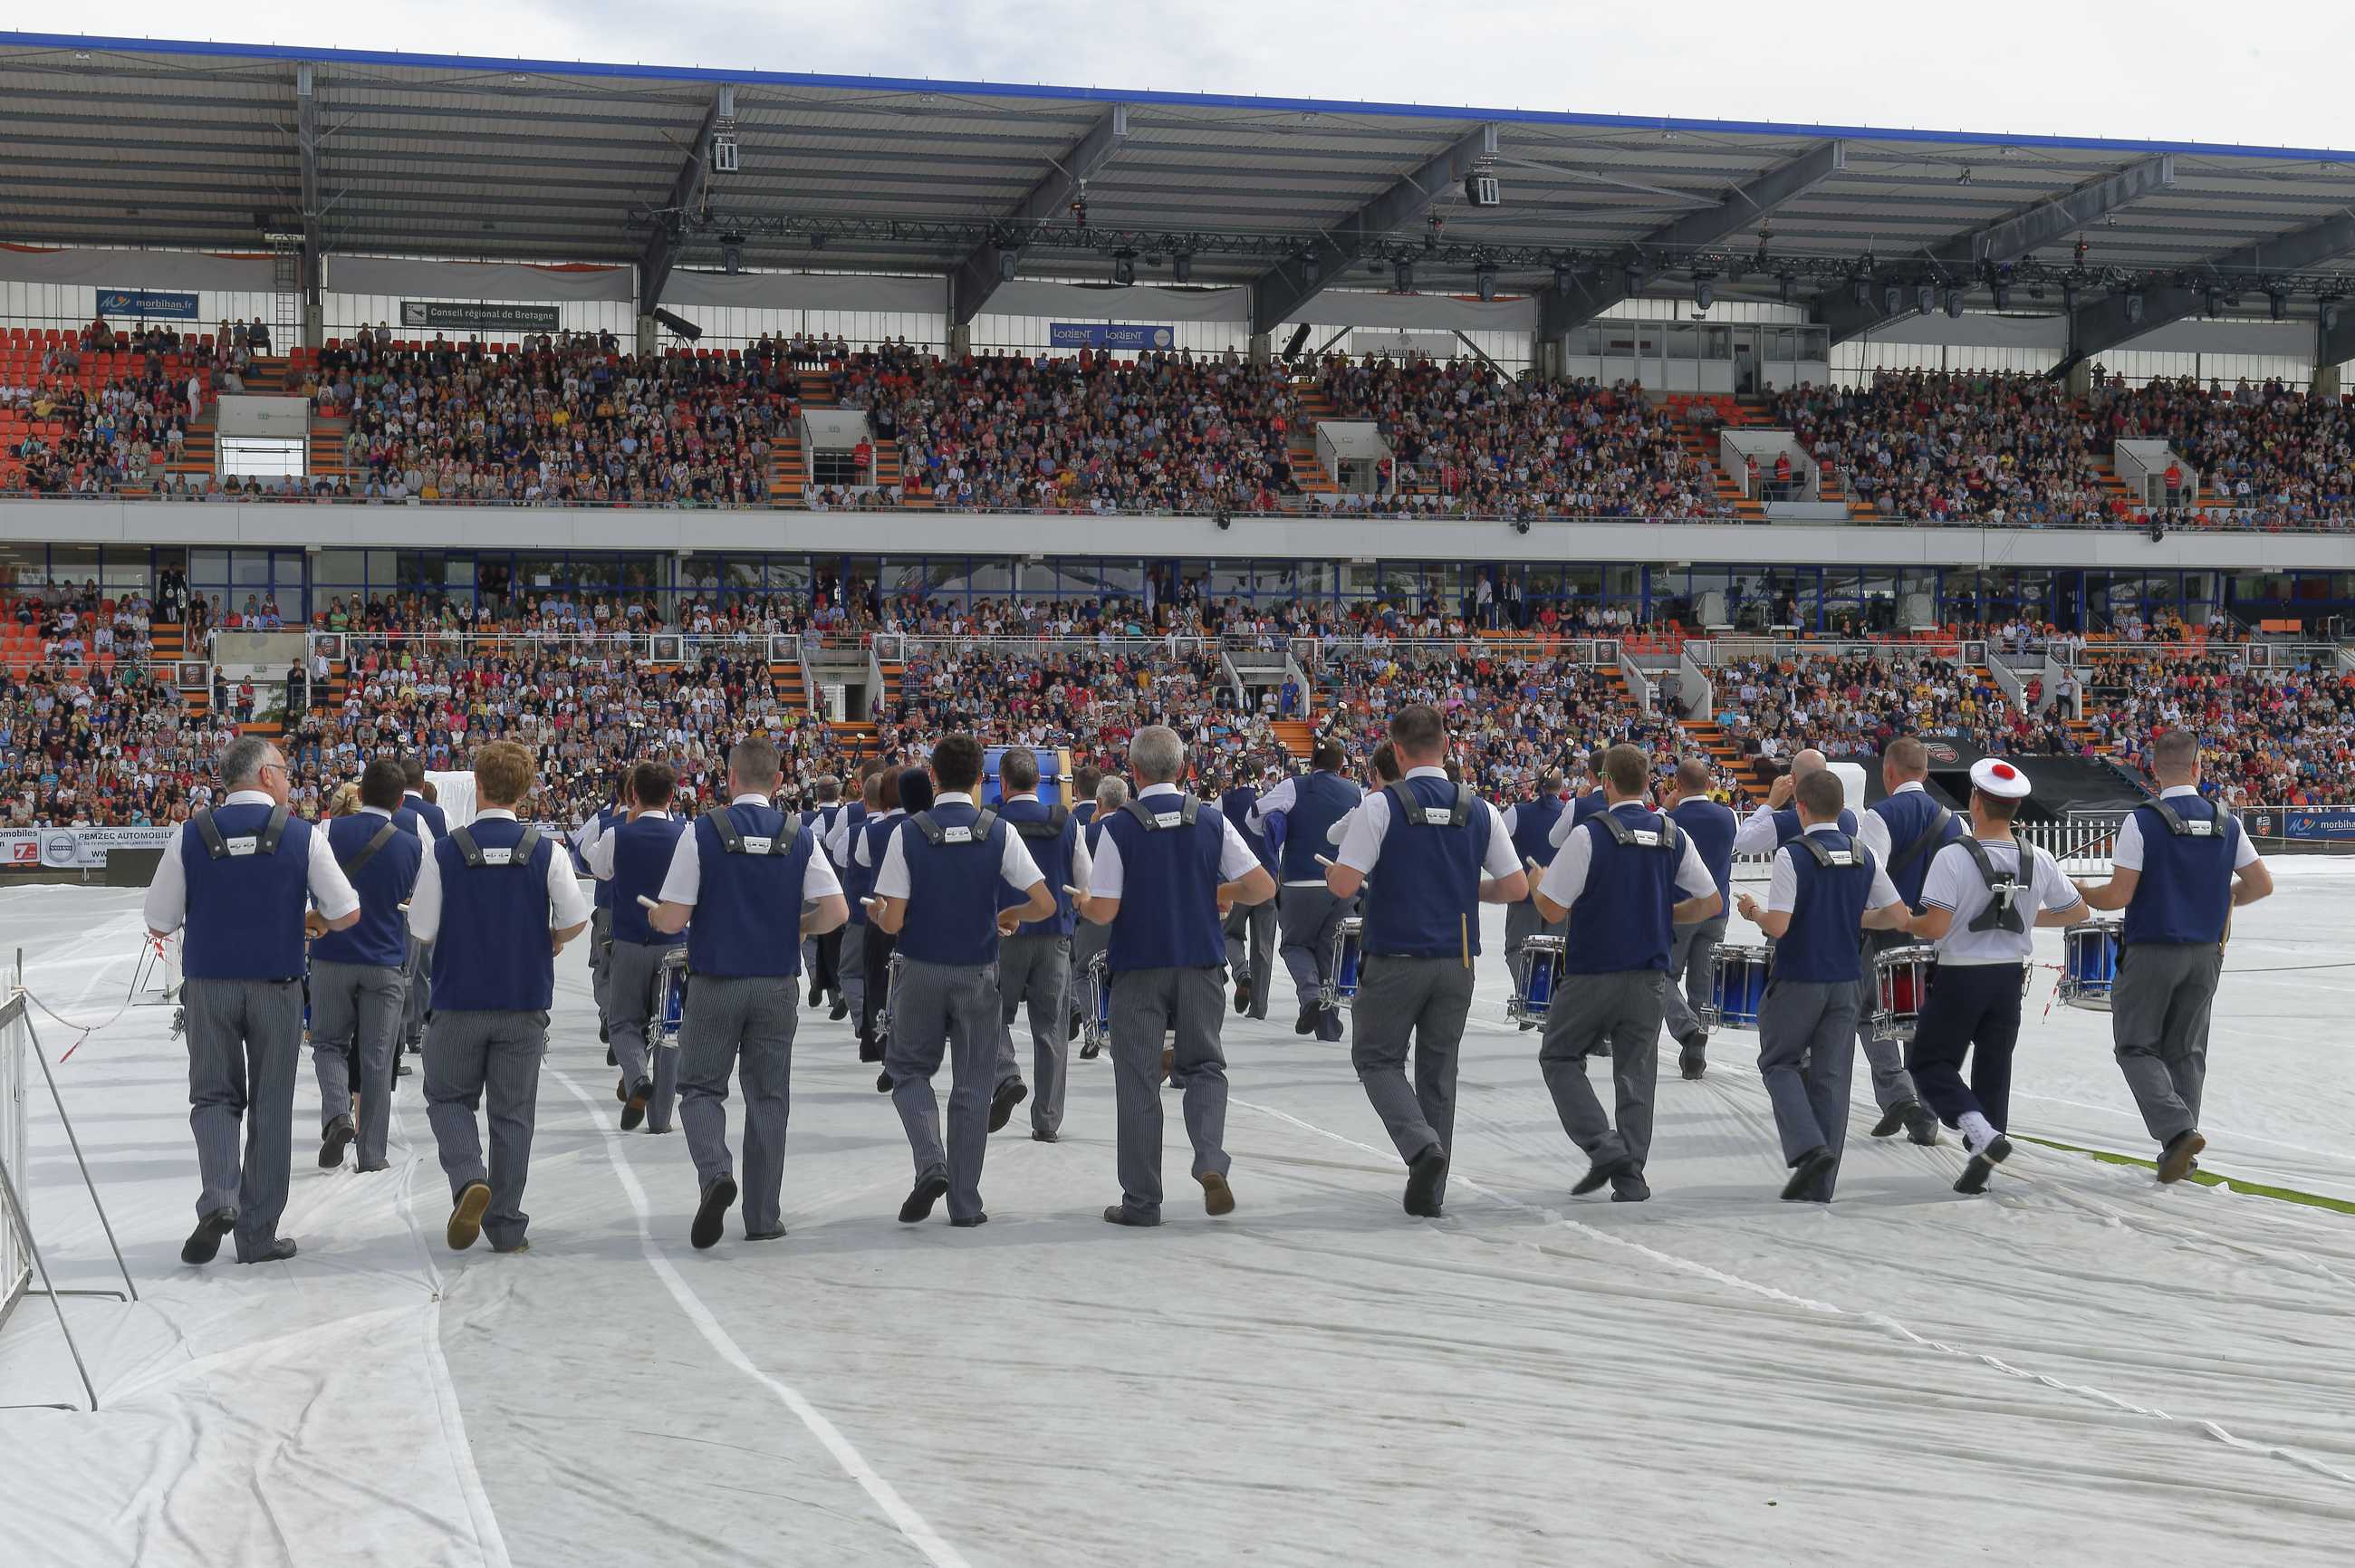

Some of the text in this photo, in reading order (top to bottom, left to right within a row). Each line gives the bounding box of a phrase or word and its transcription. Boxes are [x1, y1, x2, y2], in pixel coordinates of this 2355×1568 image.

[136, 299, 193, 309] morbihan.fr
[431, 307, 461, 317] Conseil
[466, 309, 499, 320] régional
[515, 313, 553, 322] Bretagne
[78, 832, 115, 841] PEMZEC
